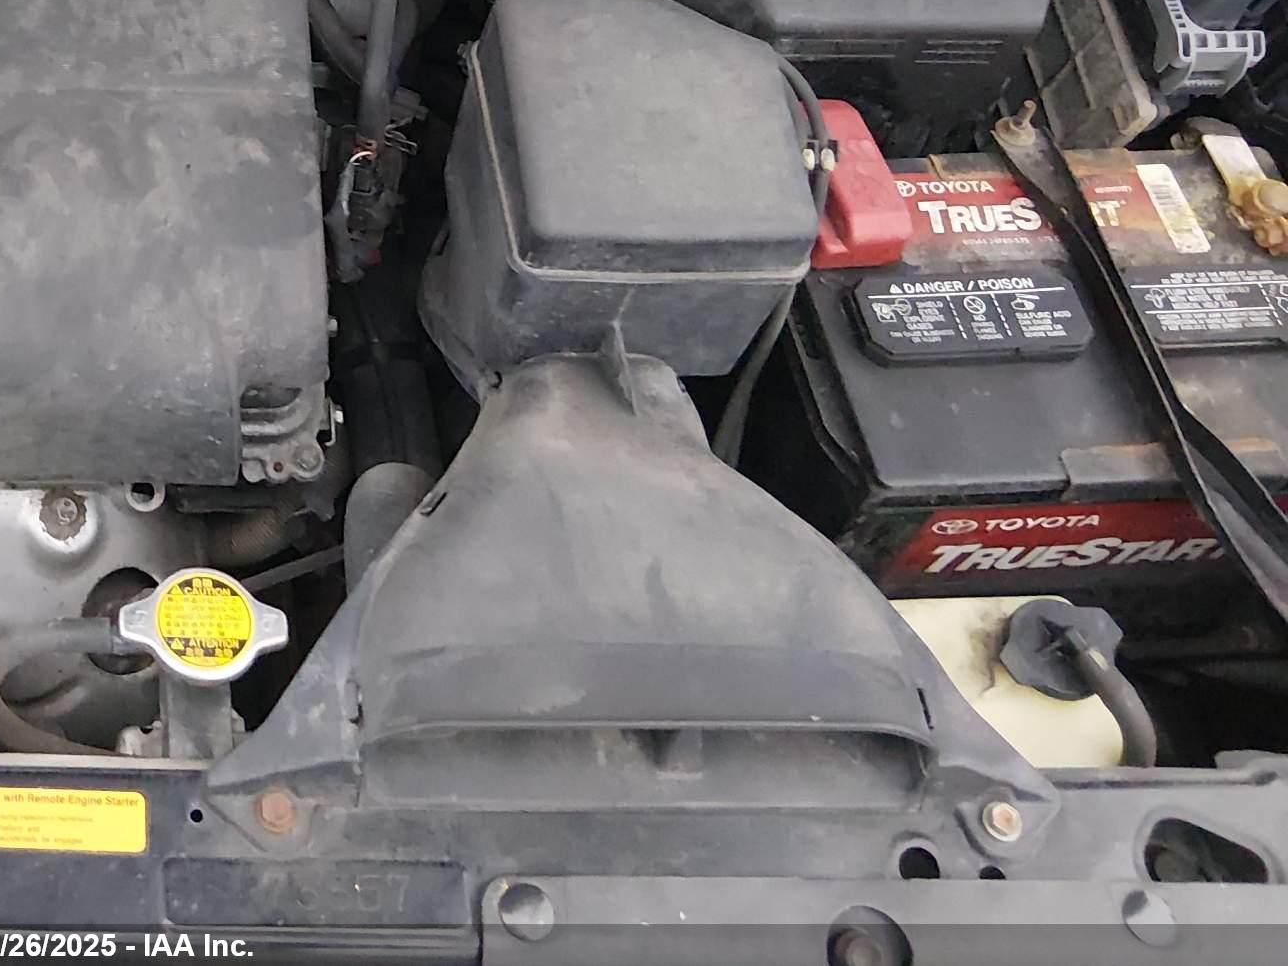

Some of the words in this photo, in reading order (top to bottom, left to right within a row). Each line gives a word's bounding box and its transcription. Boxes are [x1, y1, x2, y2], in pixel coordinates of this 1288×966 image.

[917, 180, 995, 194] TOYOTA
[903, 279, 965, 294] DANGER
[966, 280, 976, 291] /
[978, 277, 1035, 290] POISON
[984, 514, 1101, 532] TOYOTA
[924, 537, 1226, 574] TRUESTAR
[184, 586, 231, 596] CAUTION
[3, 793, 25, 802] with
[28, 793, 66, 803] Remote
[68, 794, 103, 807] Engine
[105, 795, 139, 807] Starter
